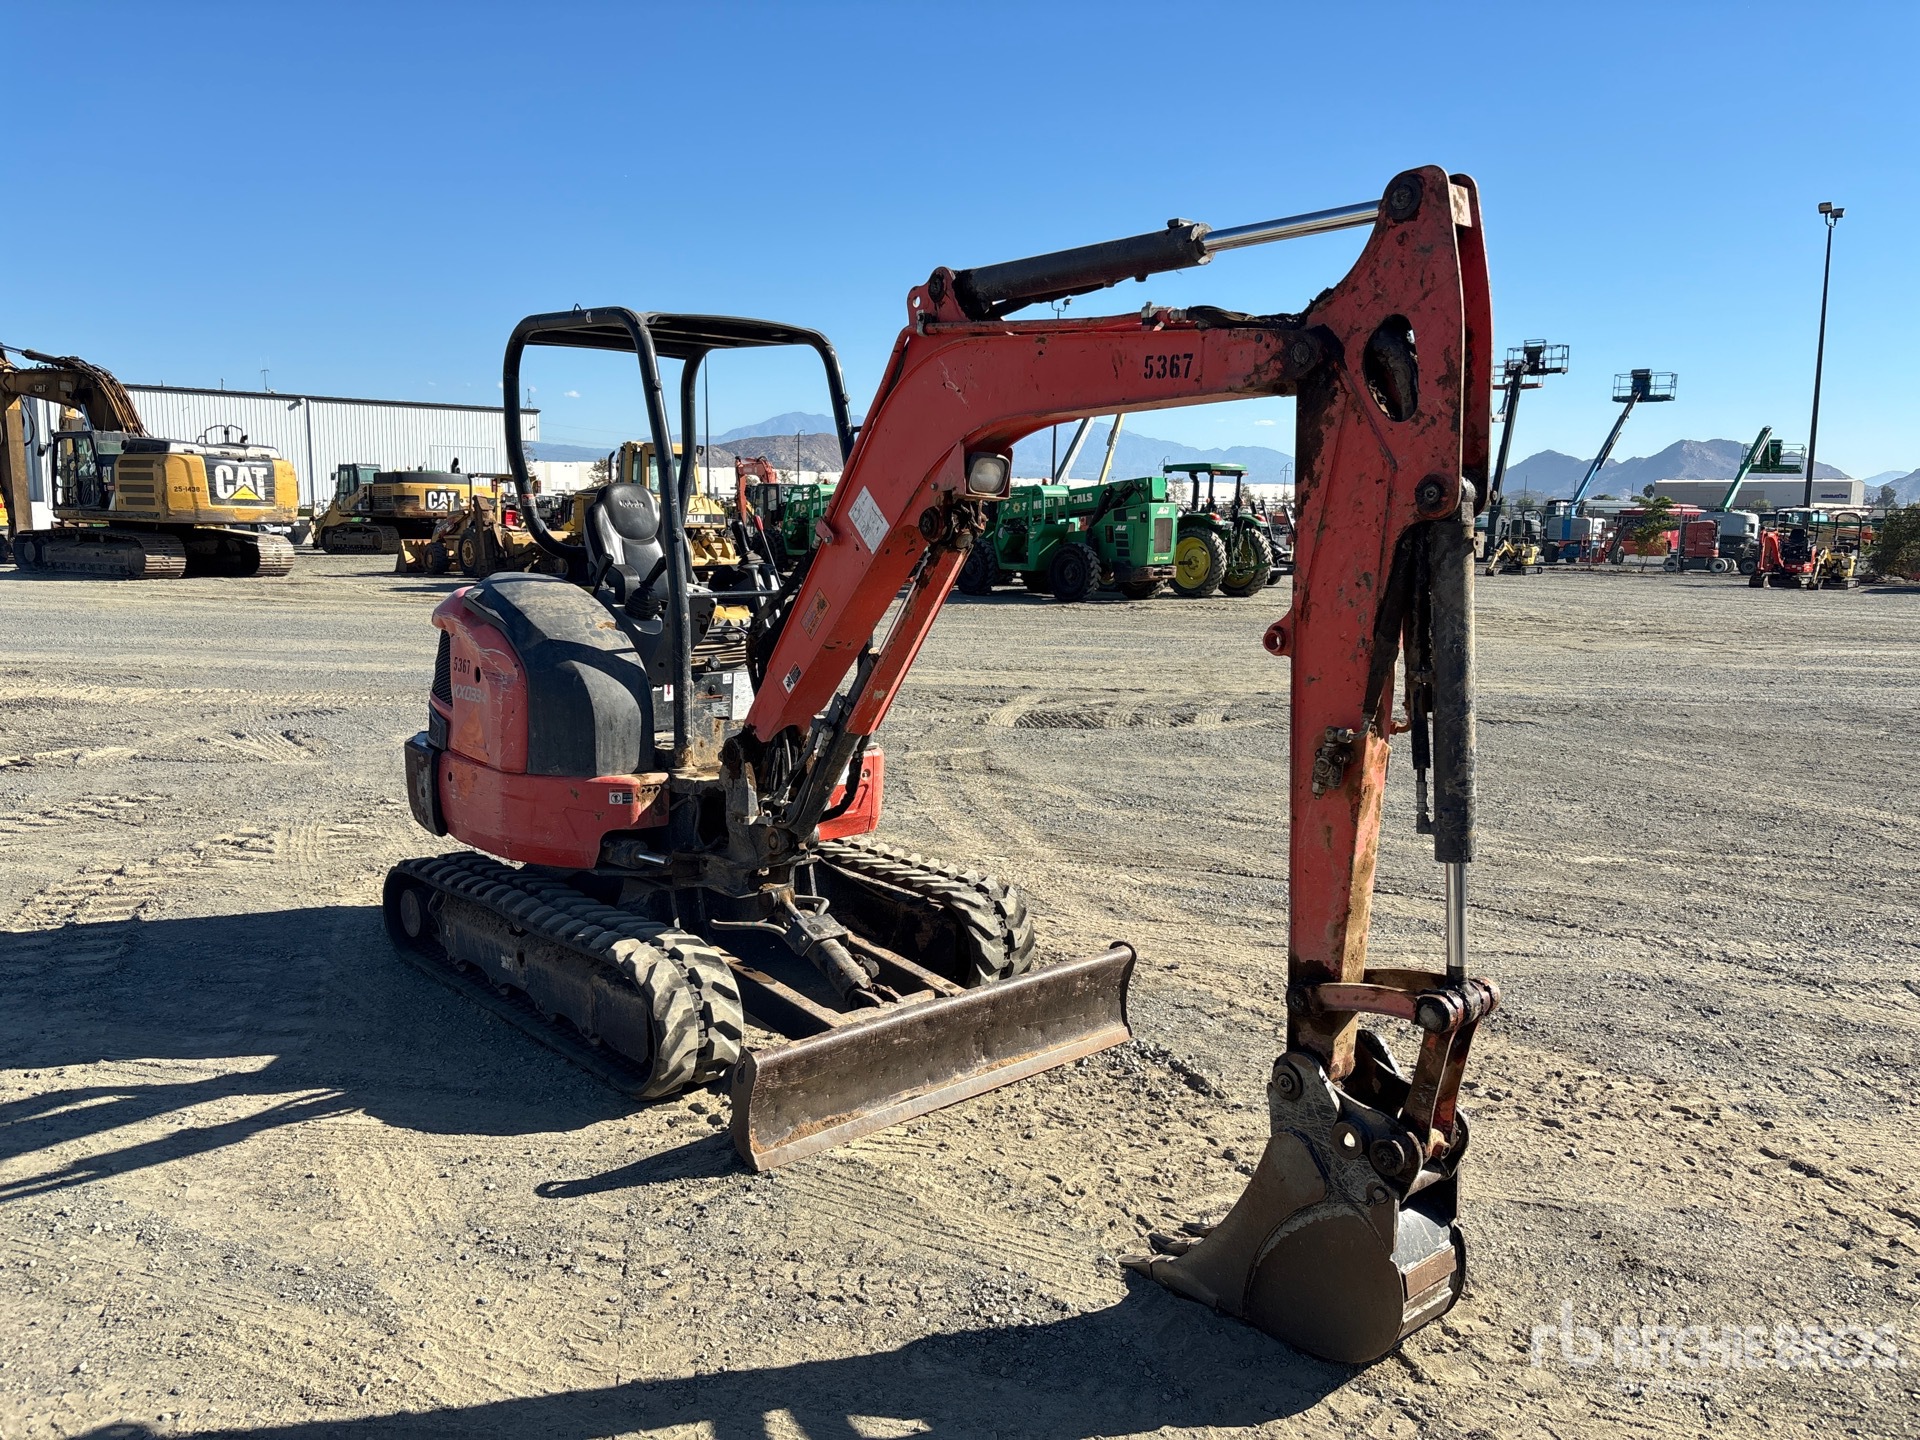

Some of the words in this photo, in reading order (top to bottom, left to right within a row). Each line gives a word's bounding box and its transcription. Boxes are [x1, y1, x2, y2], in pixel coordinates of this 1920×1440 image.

[1143, 353, 1194, 379] 5367
[101, 466, 112, 483] AT
[214, 465, 268, 500] CAT
[427, 491, 456, 509] CAT
[1057, 492, 1093, 506] RETALS
[453, 656, 471, 675] 5367
